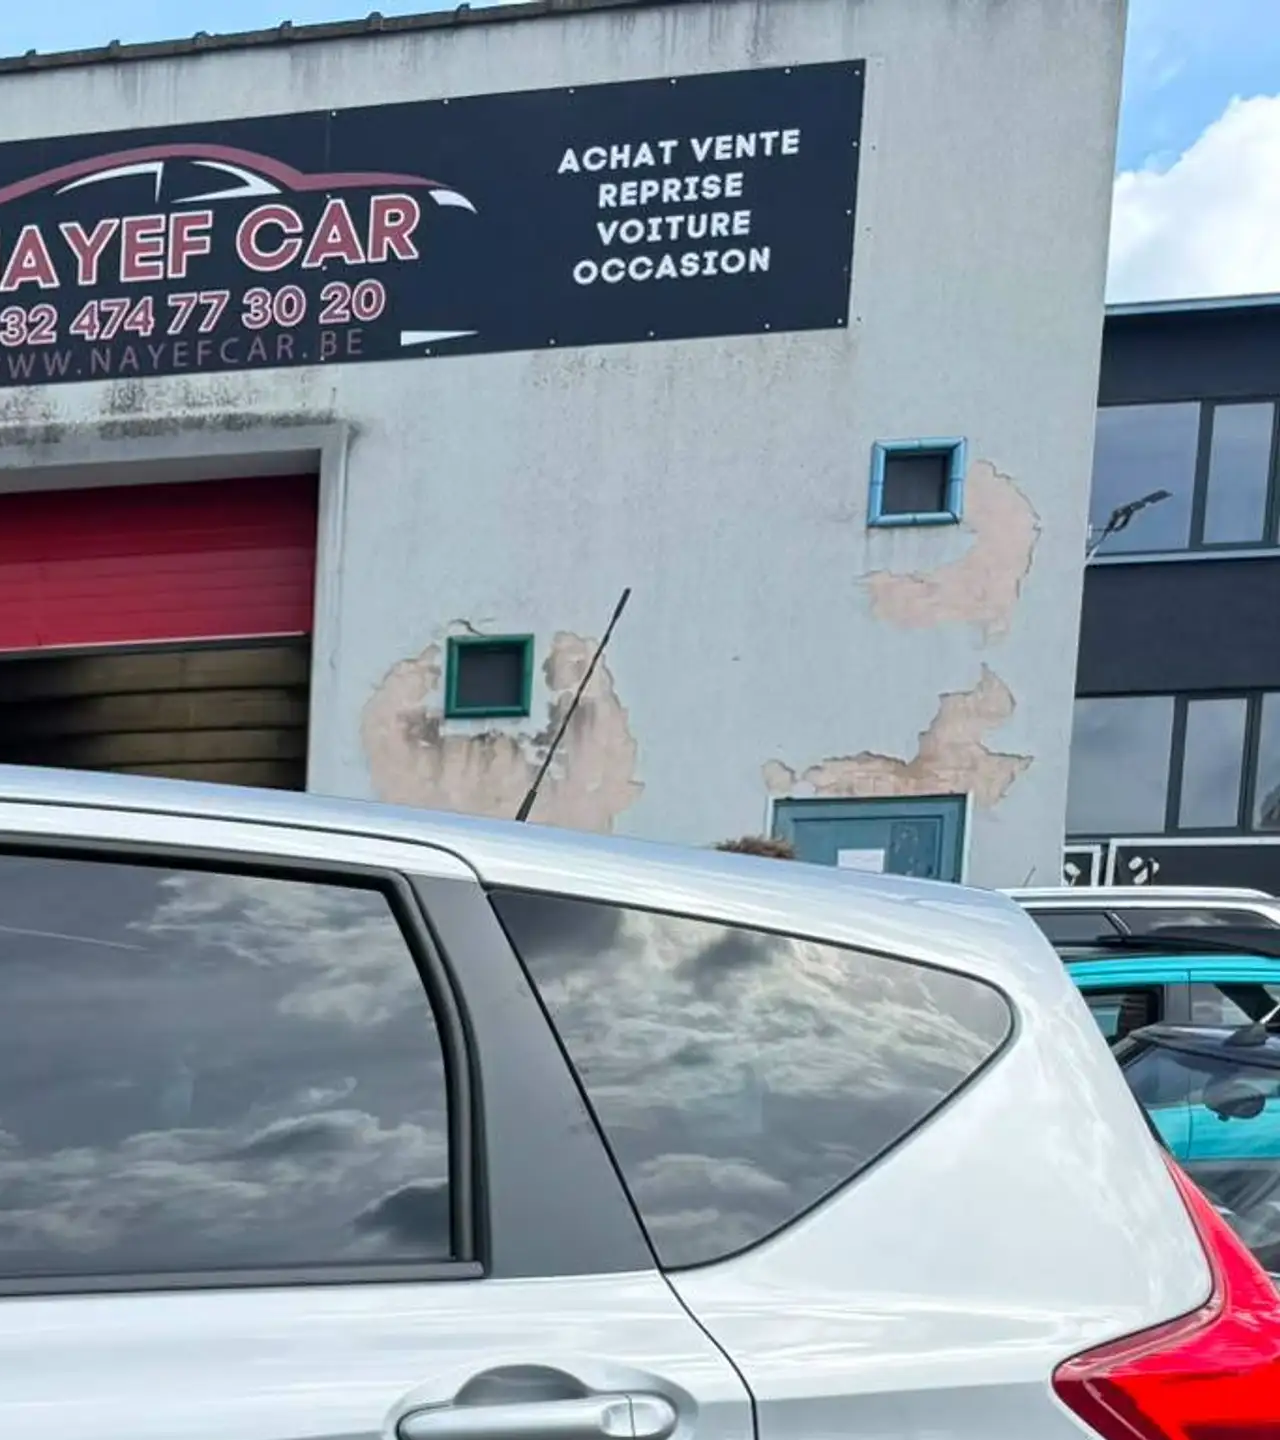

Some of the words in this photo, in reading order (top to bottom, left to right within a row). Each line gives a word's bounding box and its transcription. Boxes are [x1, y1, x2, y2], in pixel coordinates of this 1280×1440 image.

[558, 140, 678, 173] ACHAT
[691, 129, 801, 162] VENTE
[598, 172, 744, 208] REPRISE
[235, 193, 421, 272] CAR
[597, 210, 751, 245] VOITURE
[573, 247, 771, 284] OCCASION
[70, 296, 154, 340] 474
[167, 290, 230, 335] 77
[242, 285, 306, 329] 30
[318, 279, 386, 323] 20
